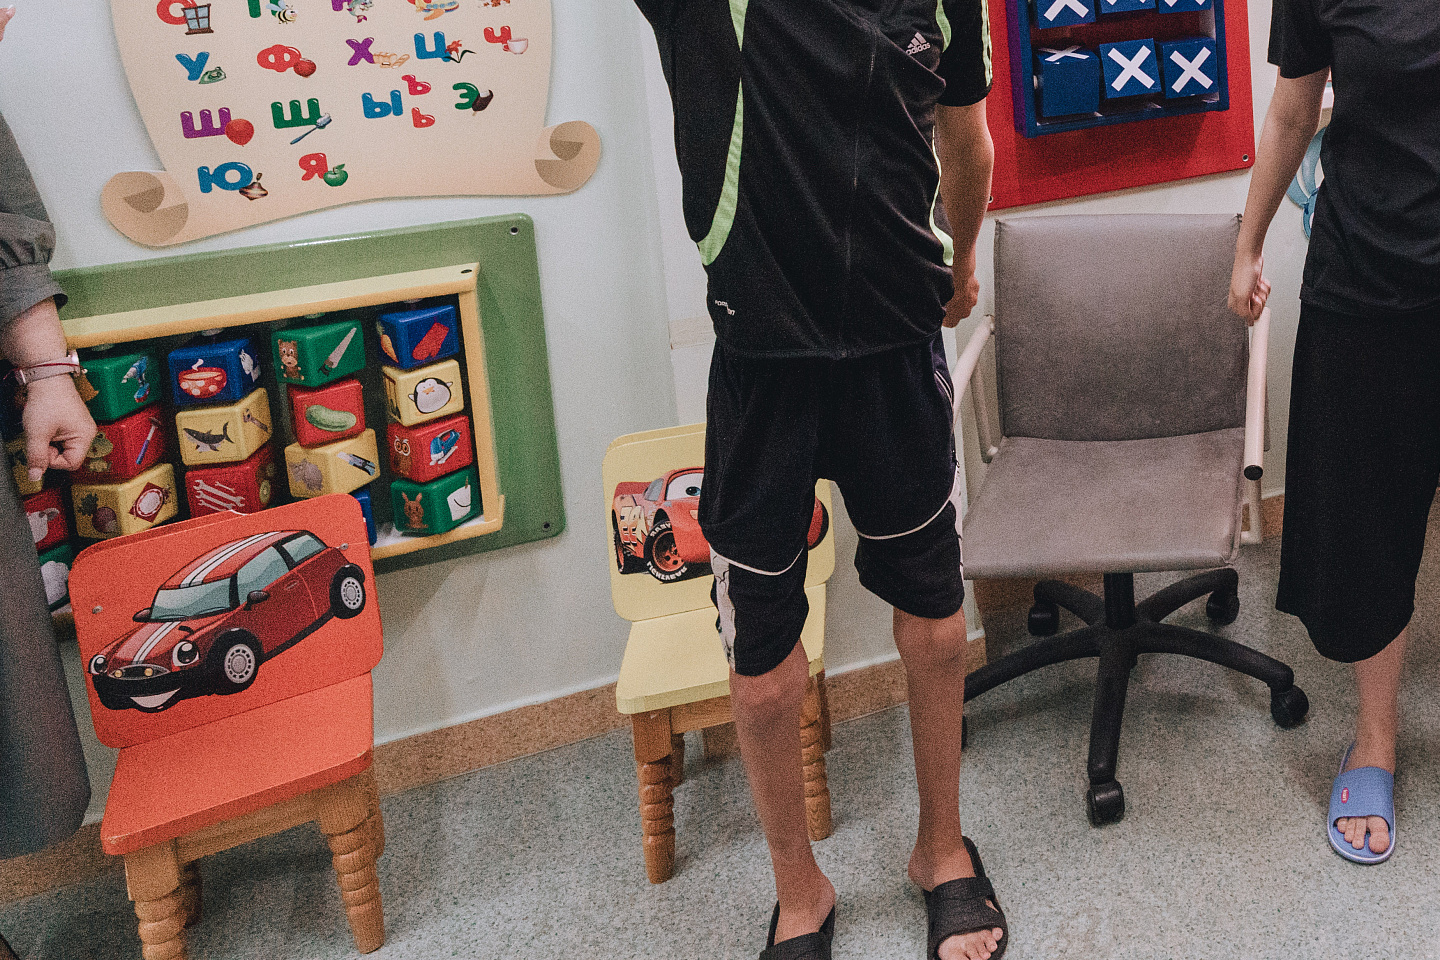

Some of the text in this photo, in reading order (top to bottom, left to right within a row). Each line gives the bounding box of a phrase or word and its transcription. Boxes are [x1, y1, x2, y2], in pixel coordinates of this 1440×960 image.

[175, 25, 512, 82] У Ф Х Ц Ч
[905, 42, 931, 56] adidas
[401, 74, 431, 95] Ъ
[452, 82, 480, 110] Э
[361, 90, 404, 119] Ы
[411, 107, 435, 128] Ь
[180, 107, 232, 139] Ш
[197, 152, 328, 193] Ю Я
